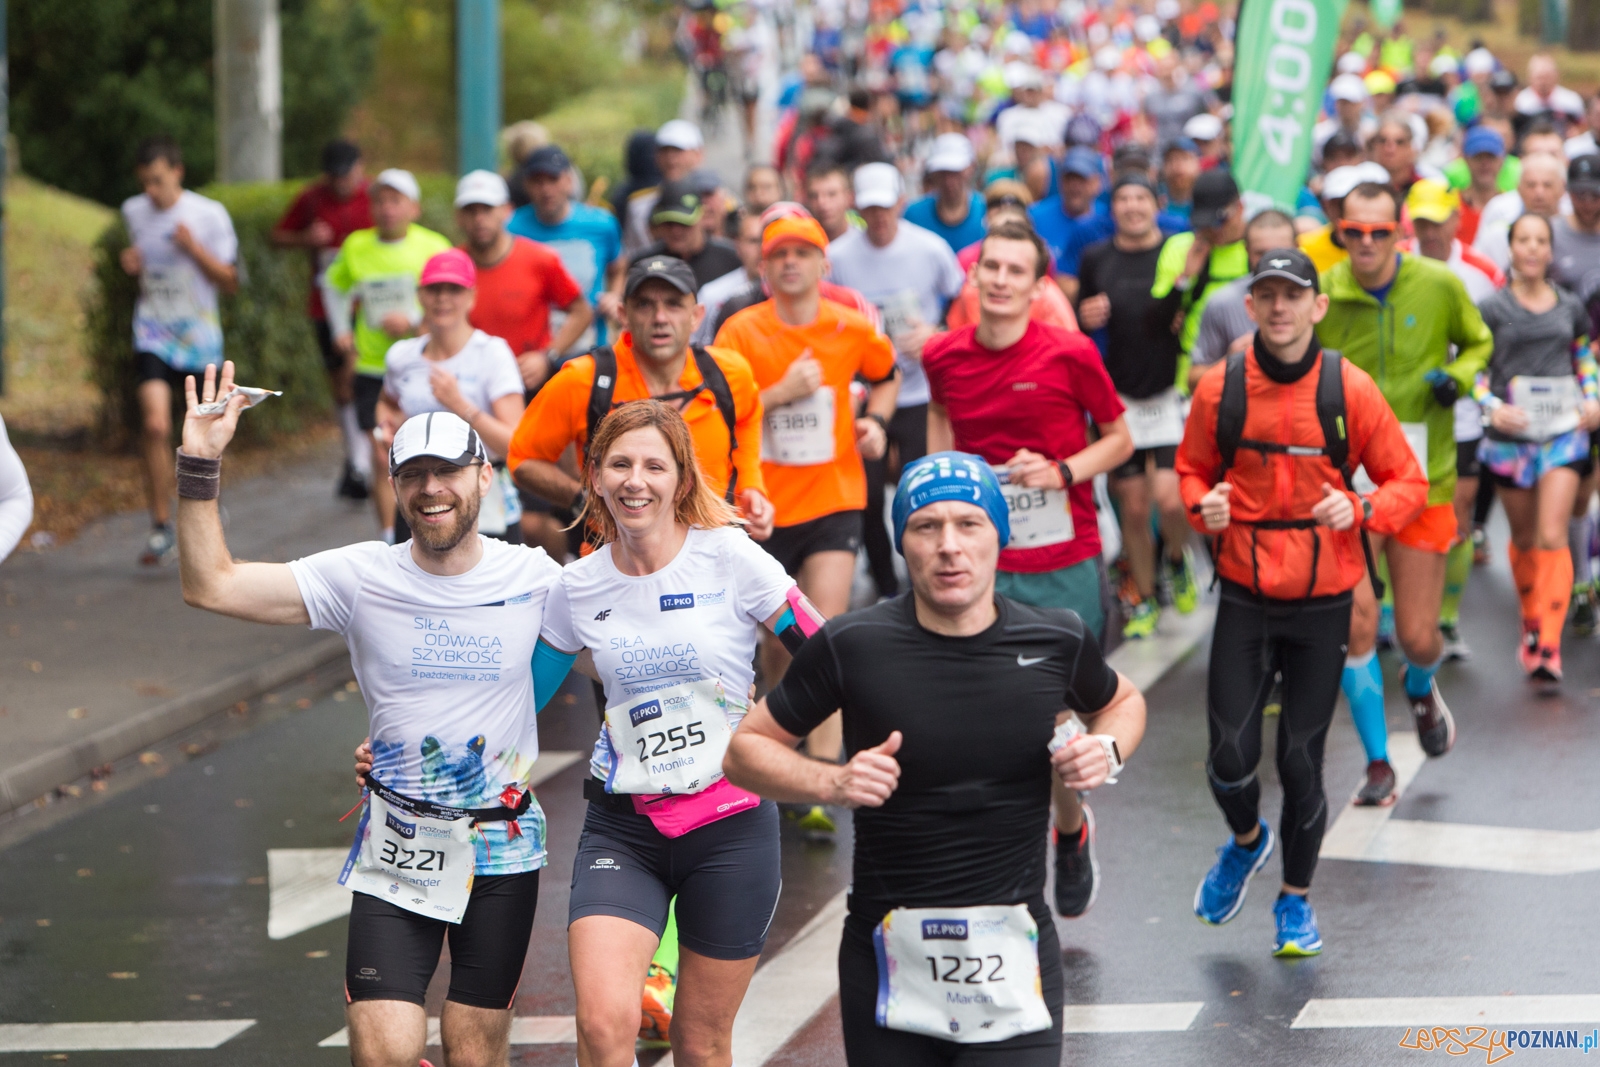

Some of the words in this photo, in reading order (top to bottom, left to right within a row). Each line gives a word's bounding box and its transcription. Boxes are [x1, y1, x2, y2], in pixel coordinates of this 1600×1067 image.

[907, 457, 981, 494] 21.1
[414, 616, 450, 631] SIŁA
[424, 633, 502, 648] ODWAGA
[610, 635, 644, 650] SIŁA
[412, 648, 503, 663] SZYBKOŚĆ
[621, 643, 697, 664] ODWAGA
[411, 669, 418, 677] 9
[419, 670, 475, 681] października
[478, 673, 500, 681] 2016
[615, 657, 700, 680] SZYBKOŚĆ
[623, 687, 631, 695] 9
[632, 705, 658, 721] 17.PKO
[665, 699, 695, 712] maraton
[636, 721, 706, 763] 2255
[652, 756, 695, 775] Monika
[379, 788, 415, 807] performance
[440, 810, 470, 818] anti-shock
[418, 830, 451, 839] maraton
[380, 839, 445, 871] 3221
[926, 954, 1005, 984] 1222
[946, 992, 993, 1005] Marcin
